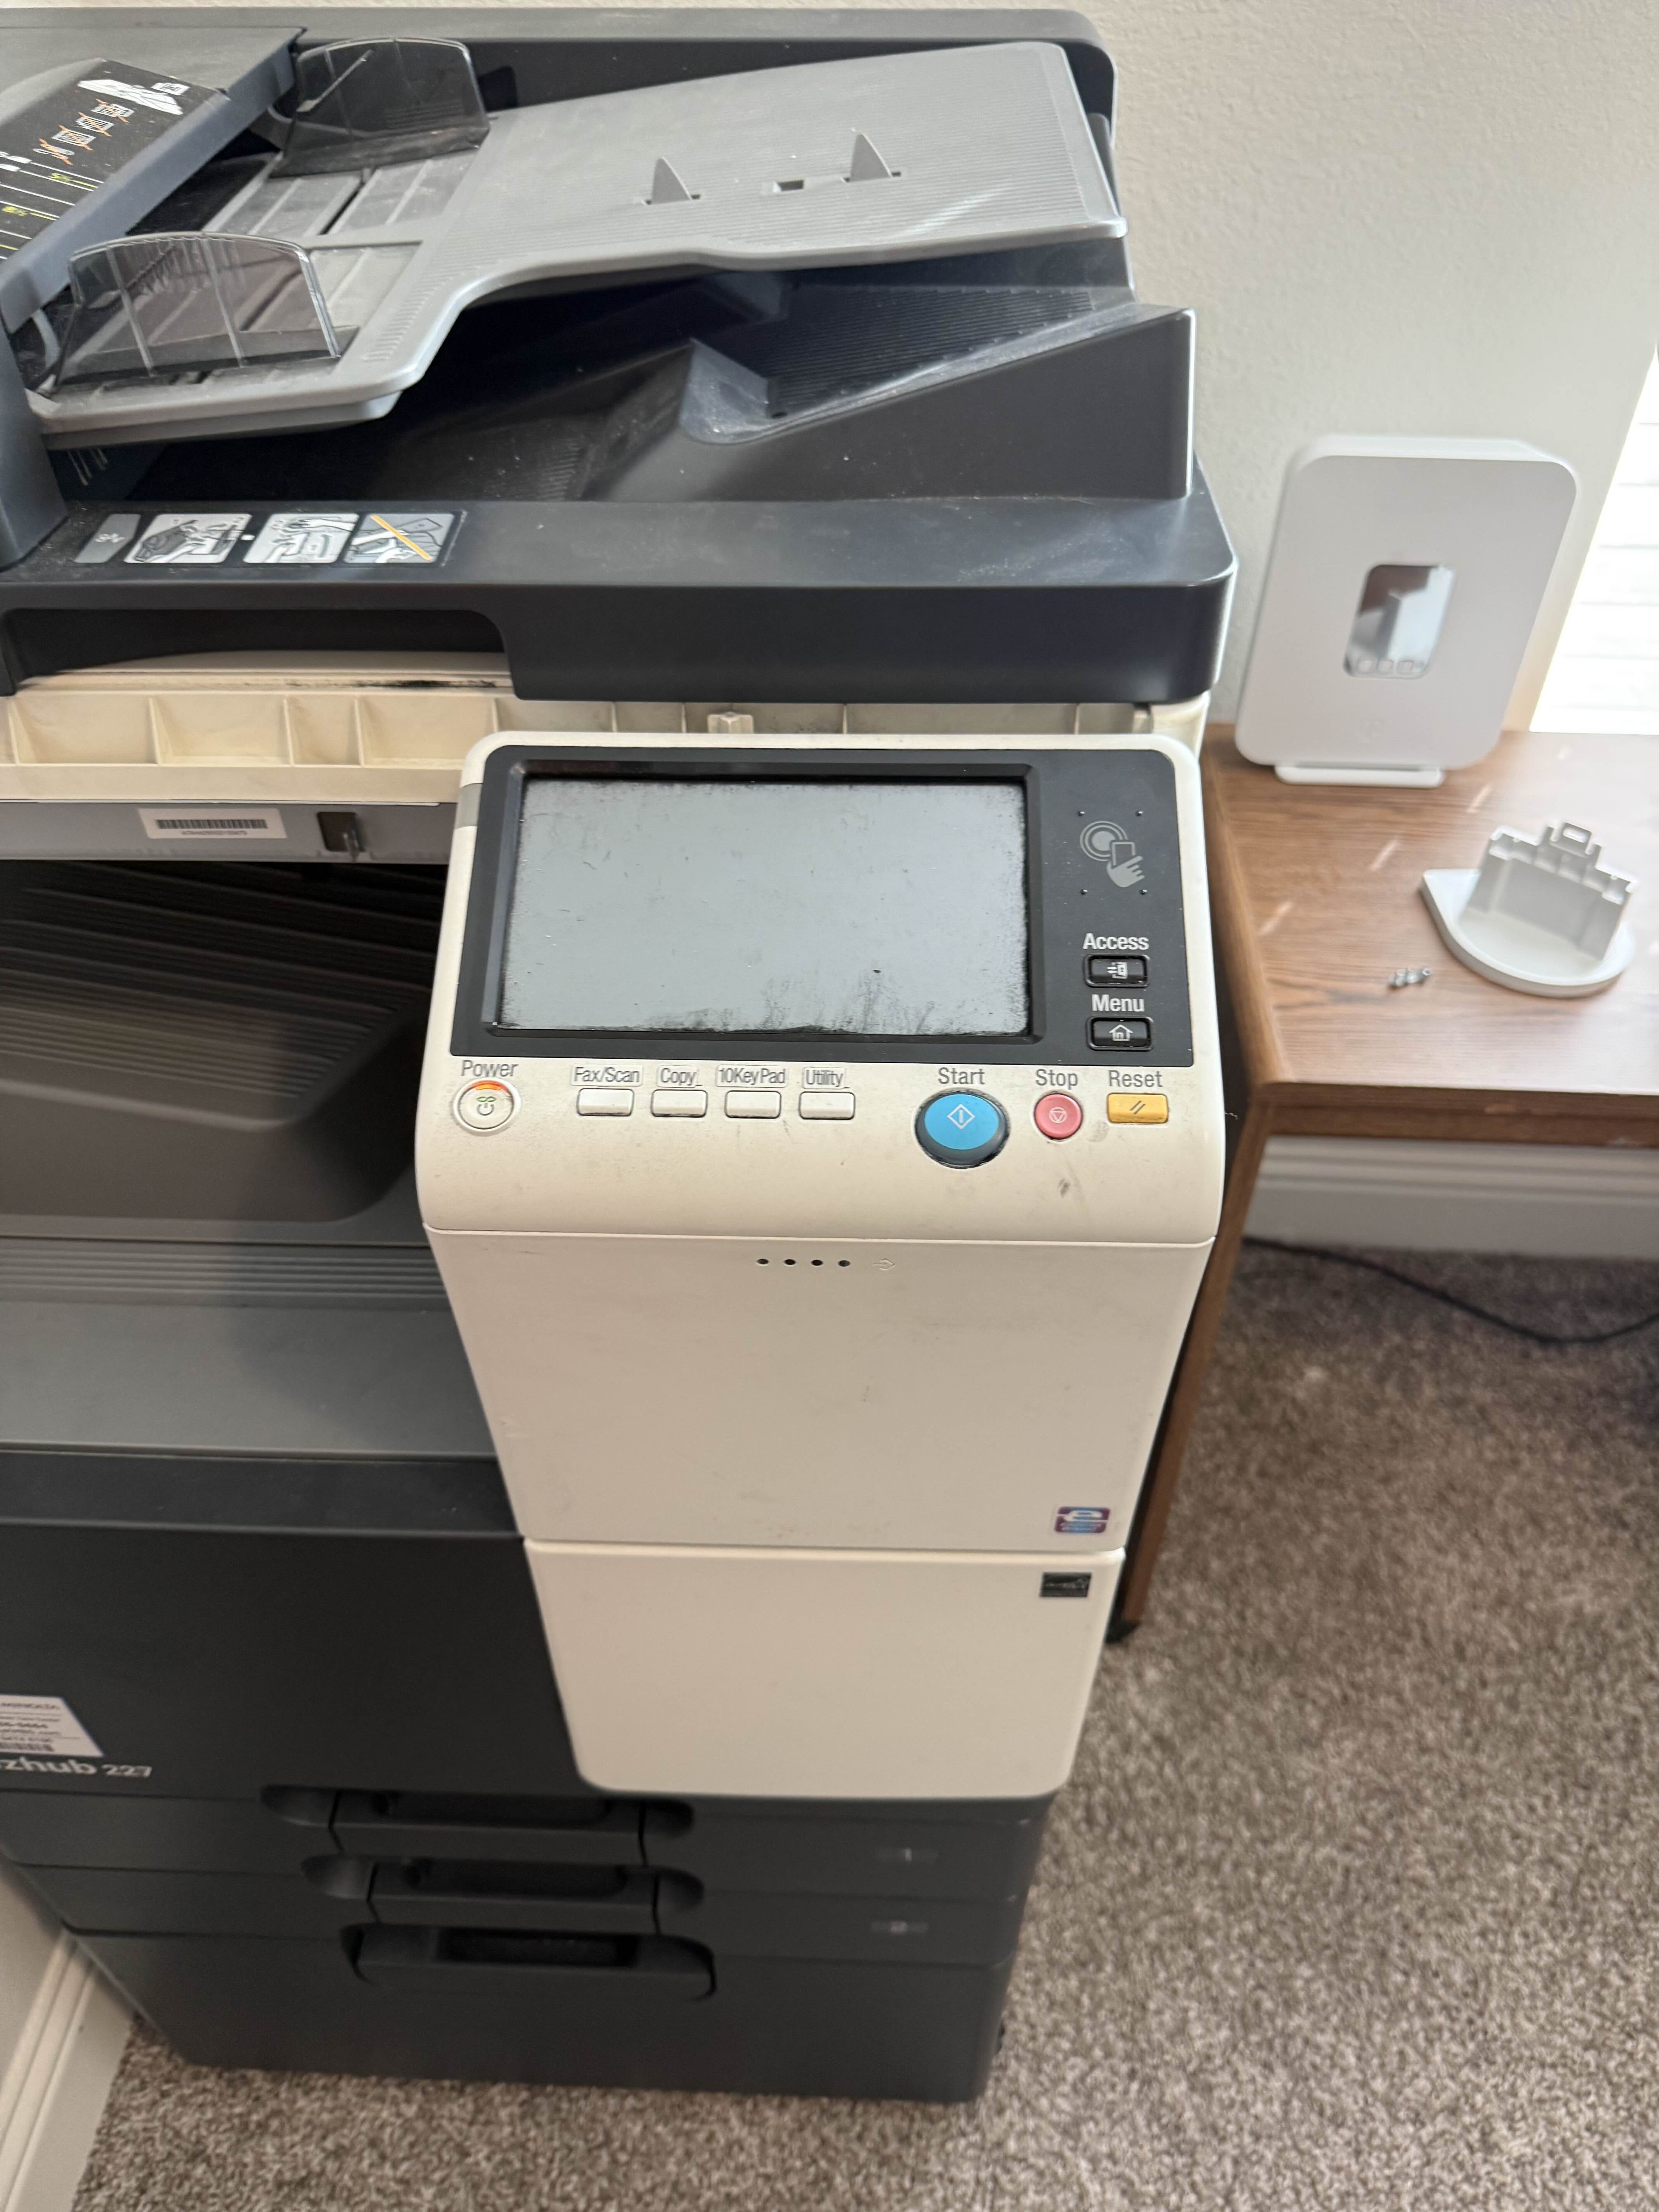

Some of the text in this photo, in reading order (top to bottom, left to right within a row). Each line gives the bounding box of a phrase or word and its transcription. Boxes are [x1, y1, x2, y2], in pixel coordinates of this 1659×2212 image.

[1083, 933, 1149, 950] Access
[1092, 994, 1145, 1012] Menu
[461, 1060, 518, 1077] Power
[574, 1066, 640, 1083] Fax/Scan
[660, 1067, 696, 1086] Copy
[938, 1067, 985, 1085] Start
[806, 1070, 843, 1087] Utility
[1036, 1069, 1078, 1089] Stop
[1108, 1070, 1163, 1087] Reset
